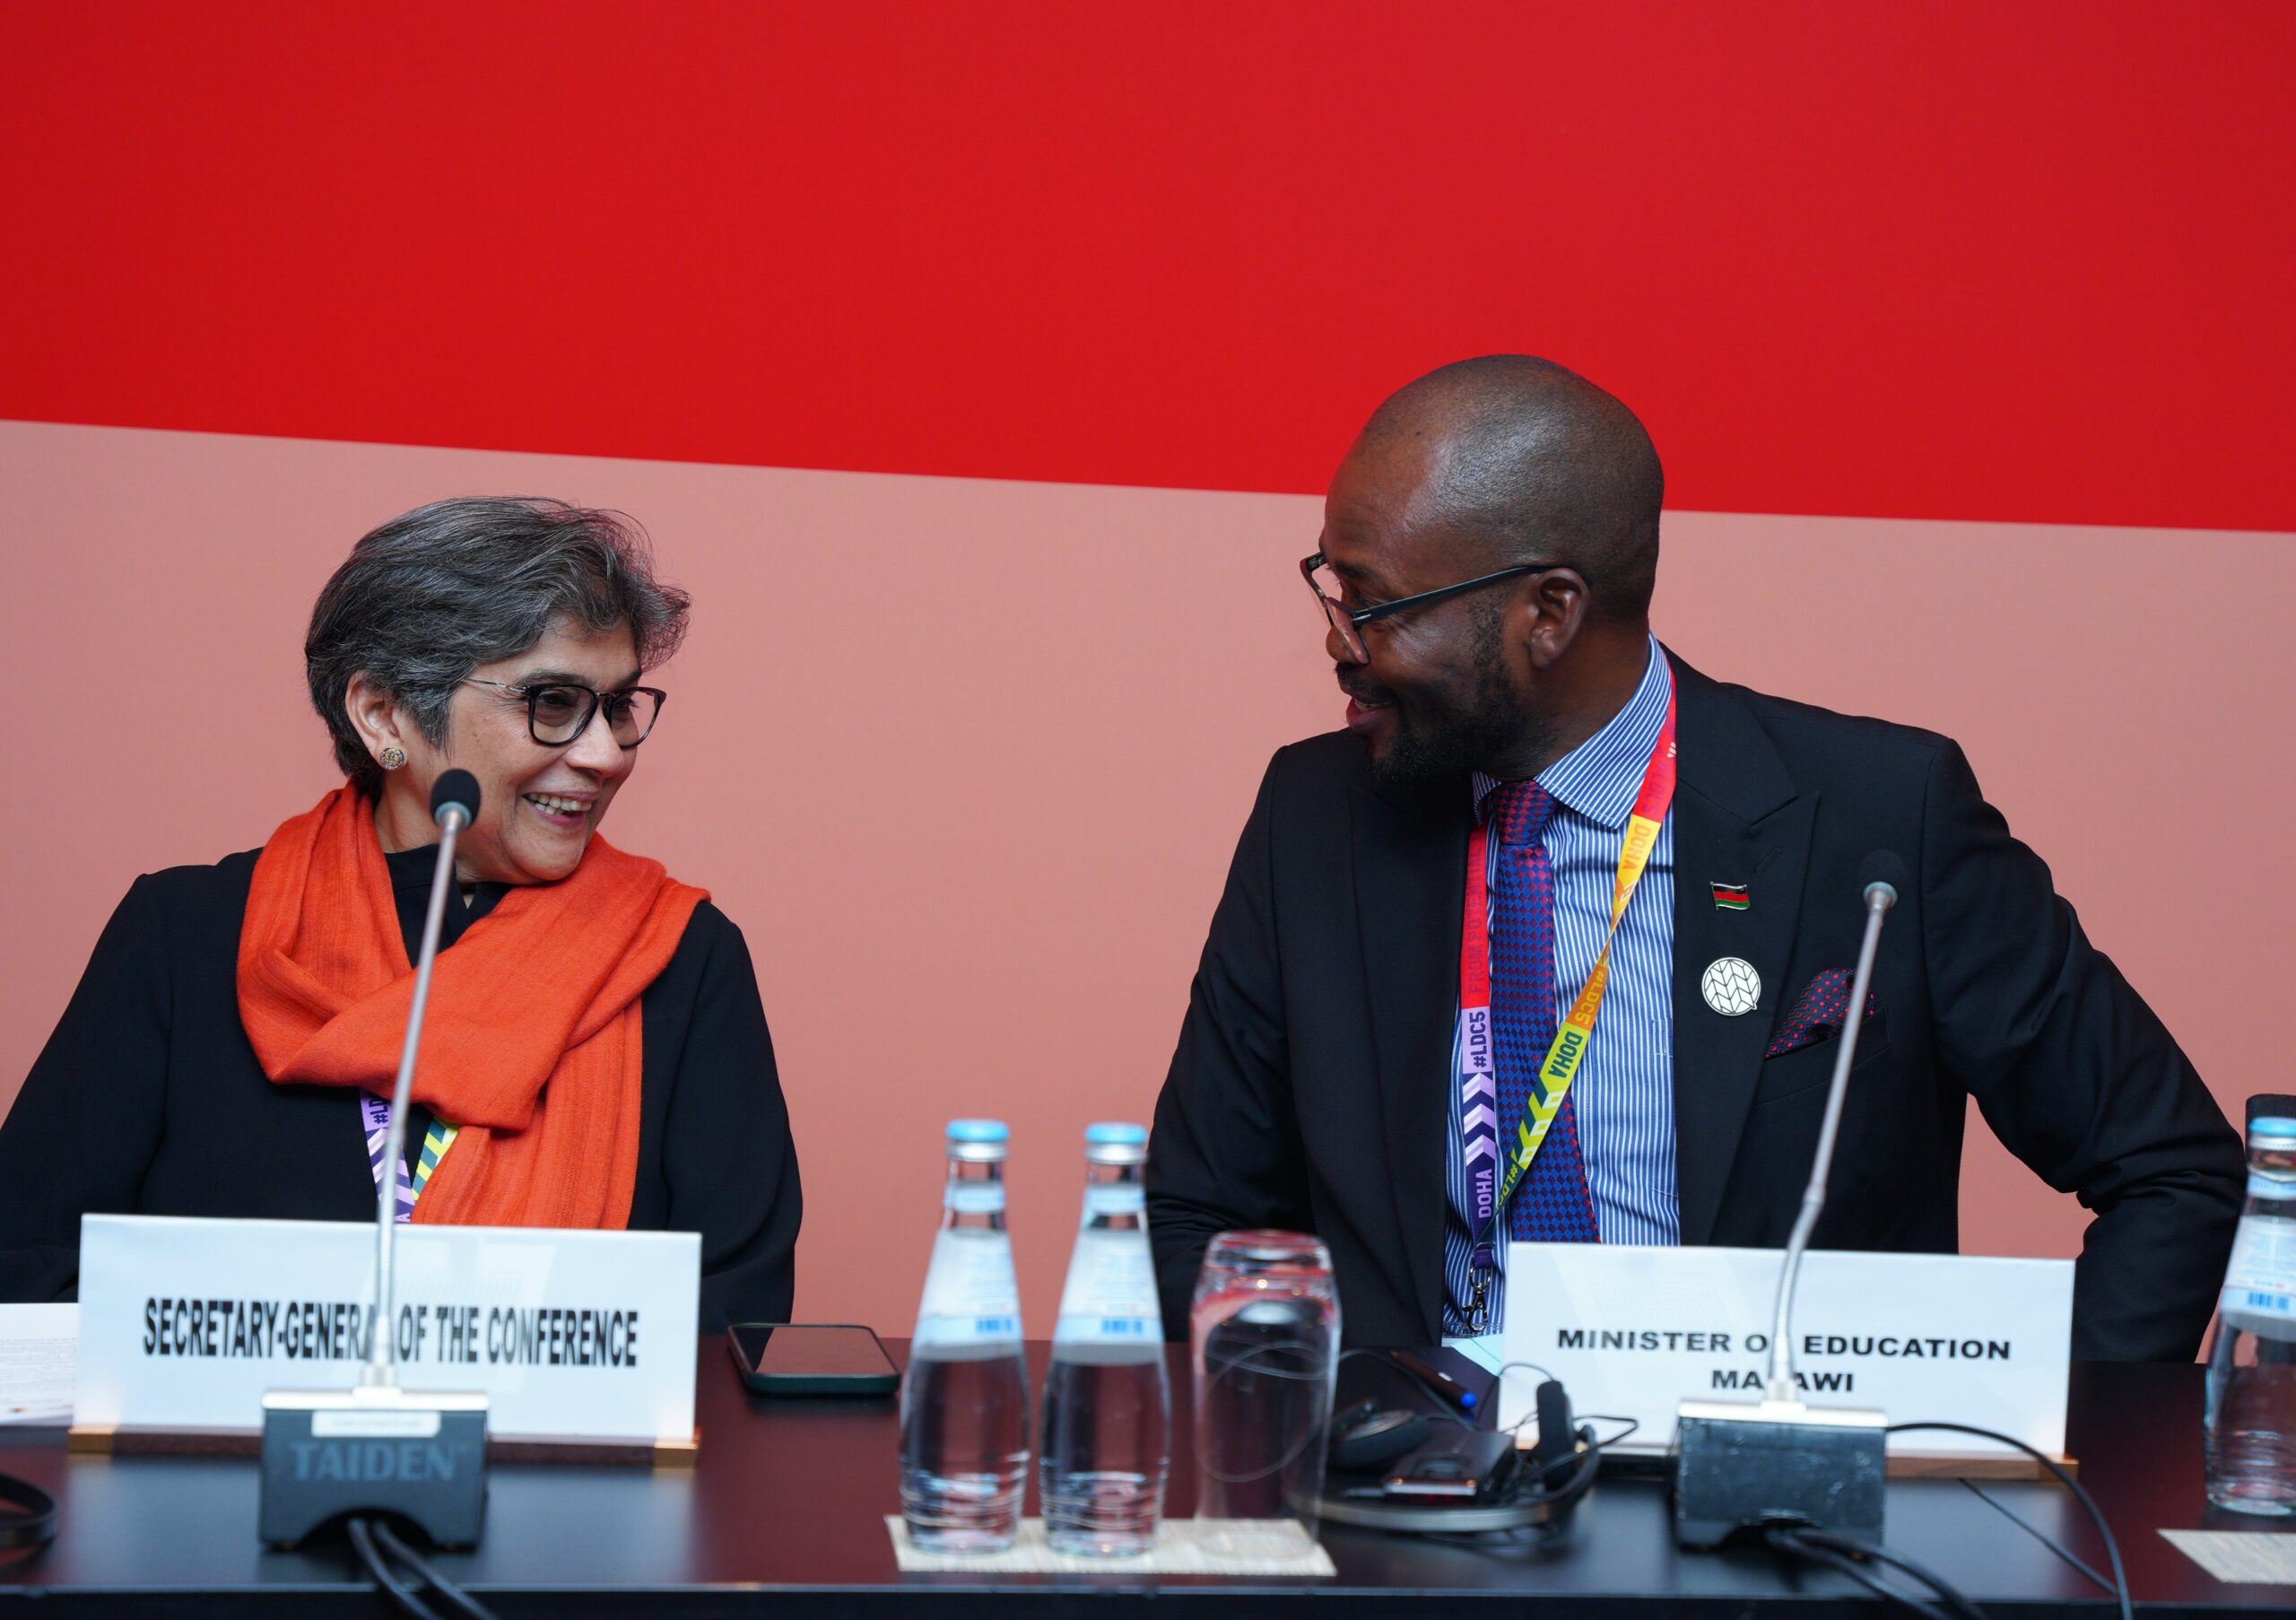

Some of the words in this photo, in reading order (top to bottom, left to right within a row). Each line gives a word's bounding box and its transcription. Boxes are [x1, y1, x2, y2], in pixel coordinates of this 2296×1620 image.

[1622, 823, 1652, 871] DOHA
[1576, 971, 1605, 1024] #LDC5
[1469, 1010, 1488, 1068] #LDC5
[1548, 1031, 1583, 1080] DOHA
[1475, 1168, 1492, 1219] DOHA
[143, 1297, 393, 1362] SECRETARY-GENERA
[399, 1304, 428, 1362] OF
[436, 1306, 479, 1363] THE
[487, 1307, 639, 1368] CONFERENCE
[1557, 1328, 1731, 1353] MINISTER
[1803, 1335, 2011, 1361] EDUCATION
[1711, 1369, 1854, 1392] MAAWI
[289, 1442, 457, 1481] TAIDEN
